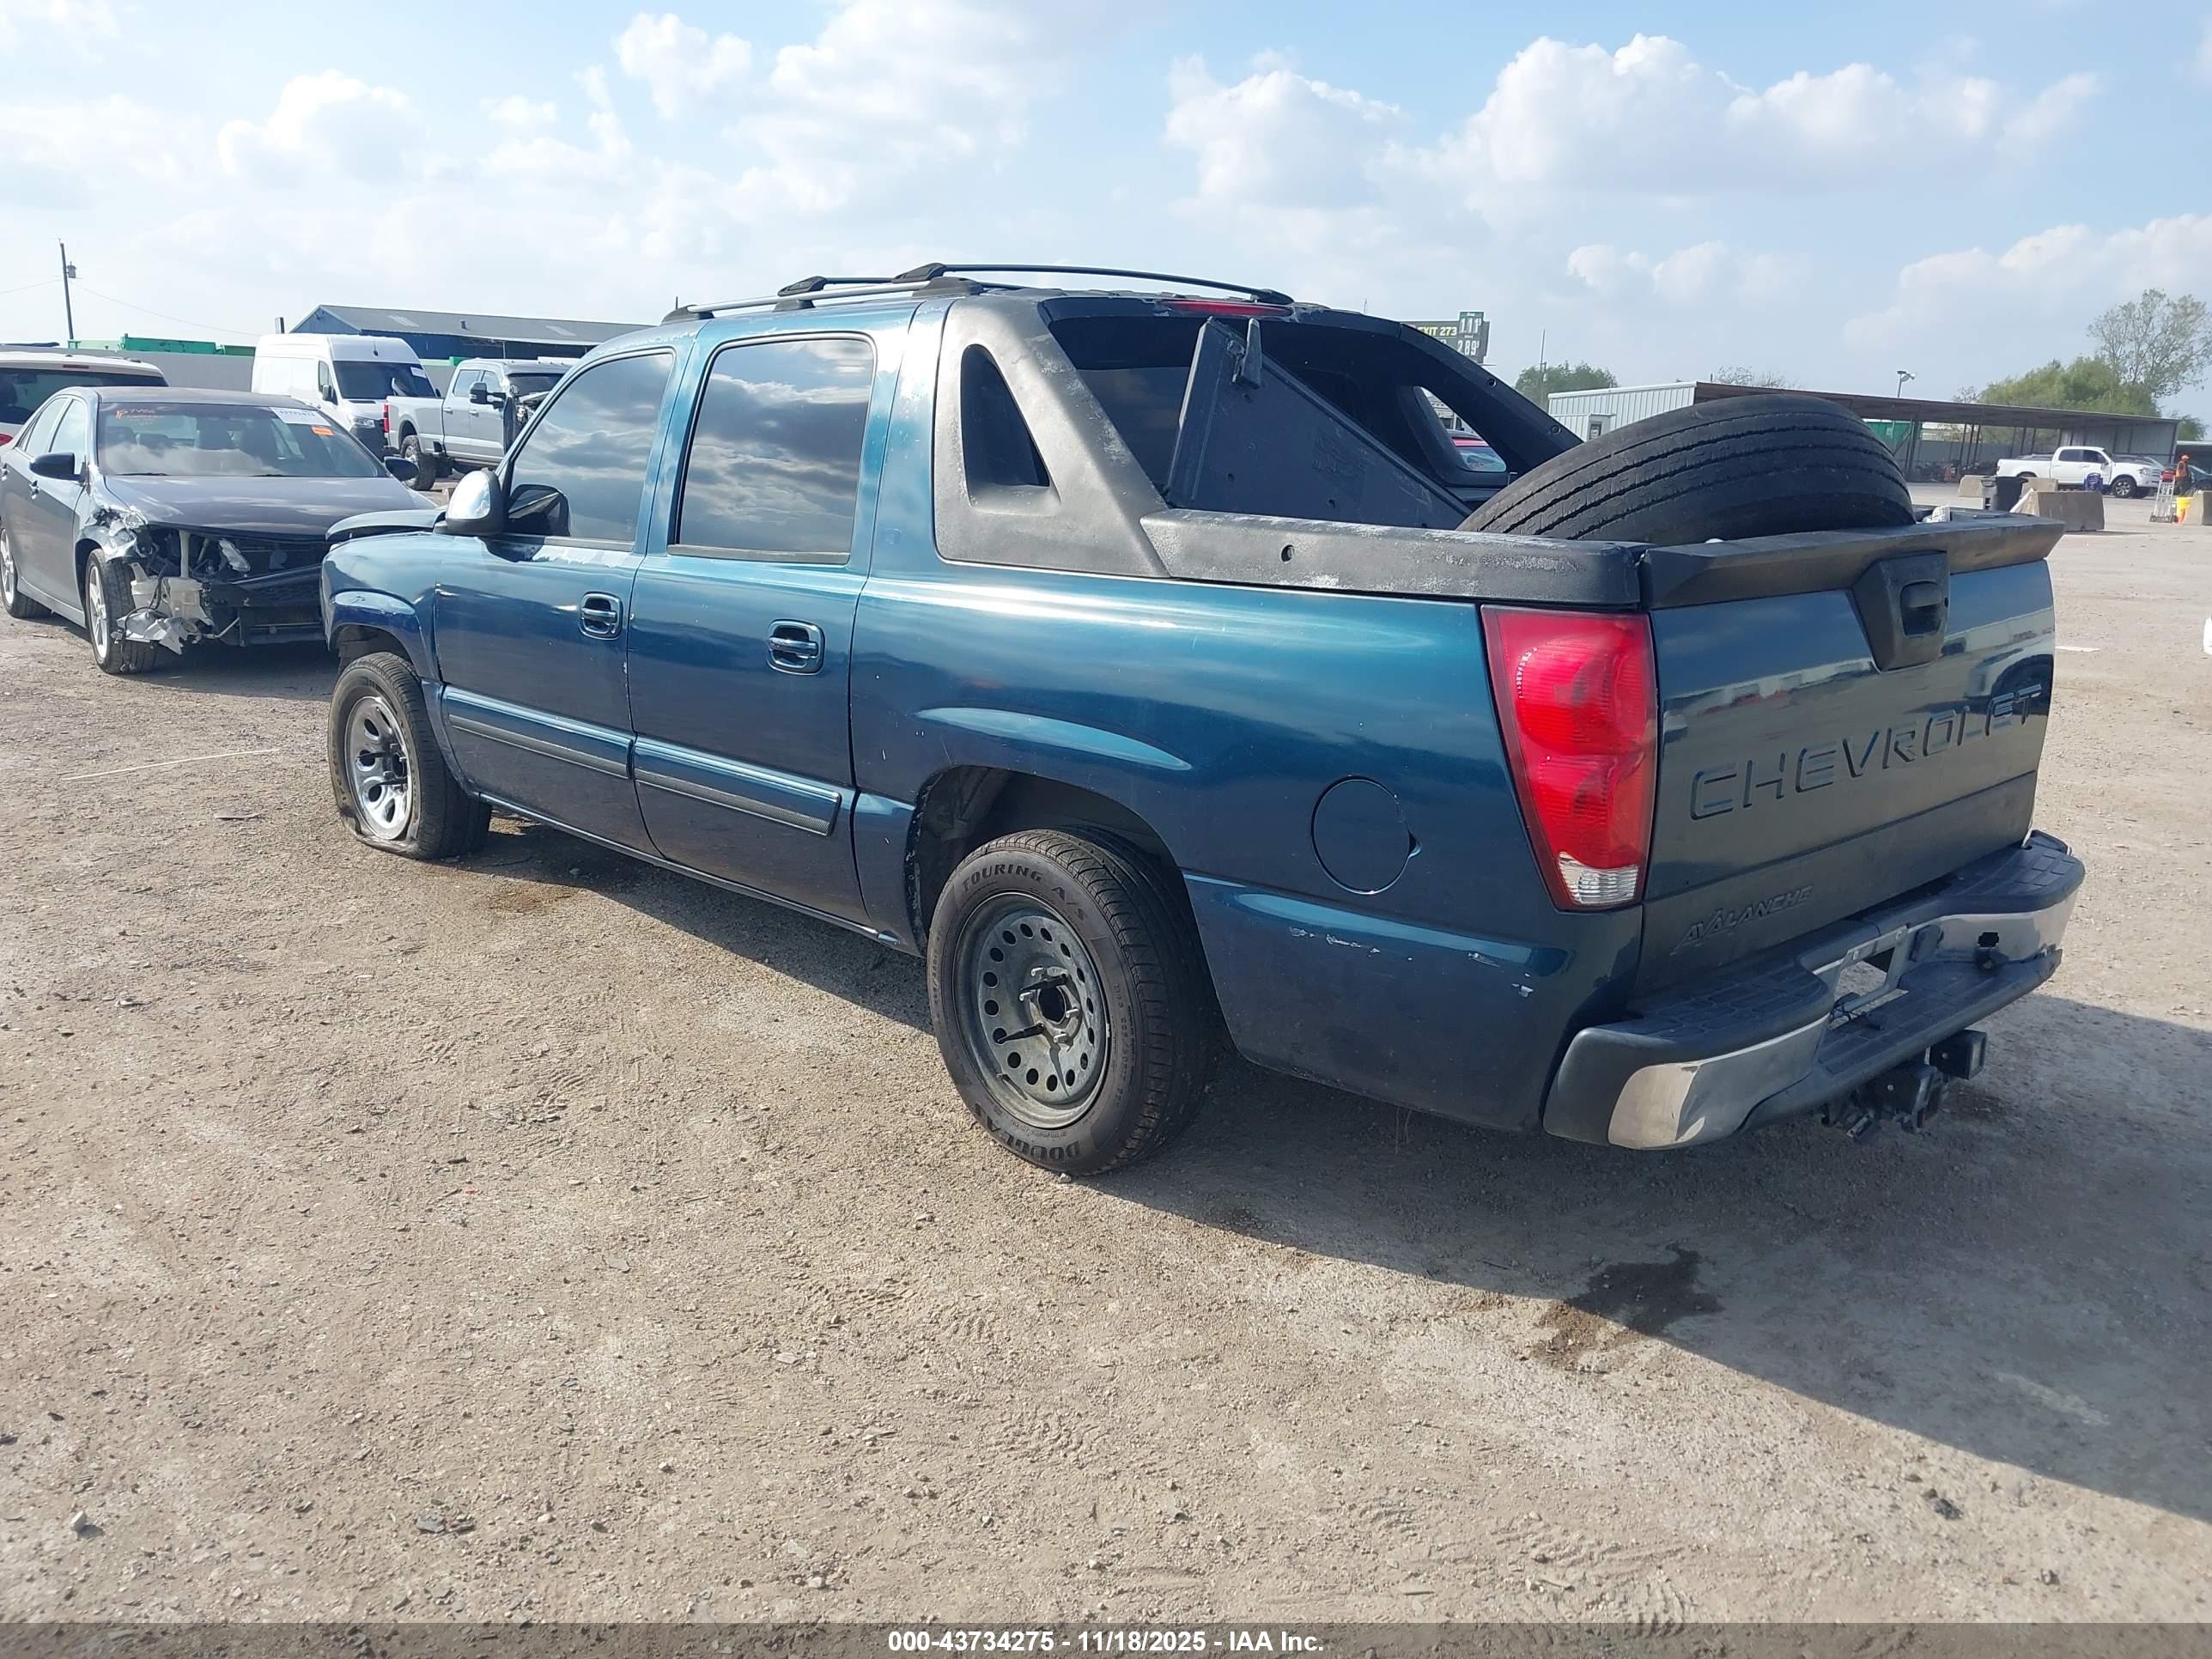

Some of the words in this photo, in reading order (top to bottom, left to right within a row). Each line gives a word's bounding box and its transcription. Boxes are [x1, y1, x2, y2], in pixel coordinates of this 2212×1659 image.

[1439, 326, 1457, 337] 273
[1689, 684, 2043, 822] CHEVROLET
[961, 864, 1044, 893] TOURING
[1050, 886, 1087, 921] A/S
[1669, 884, 1814, 956] AVALANCHE
